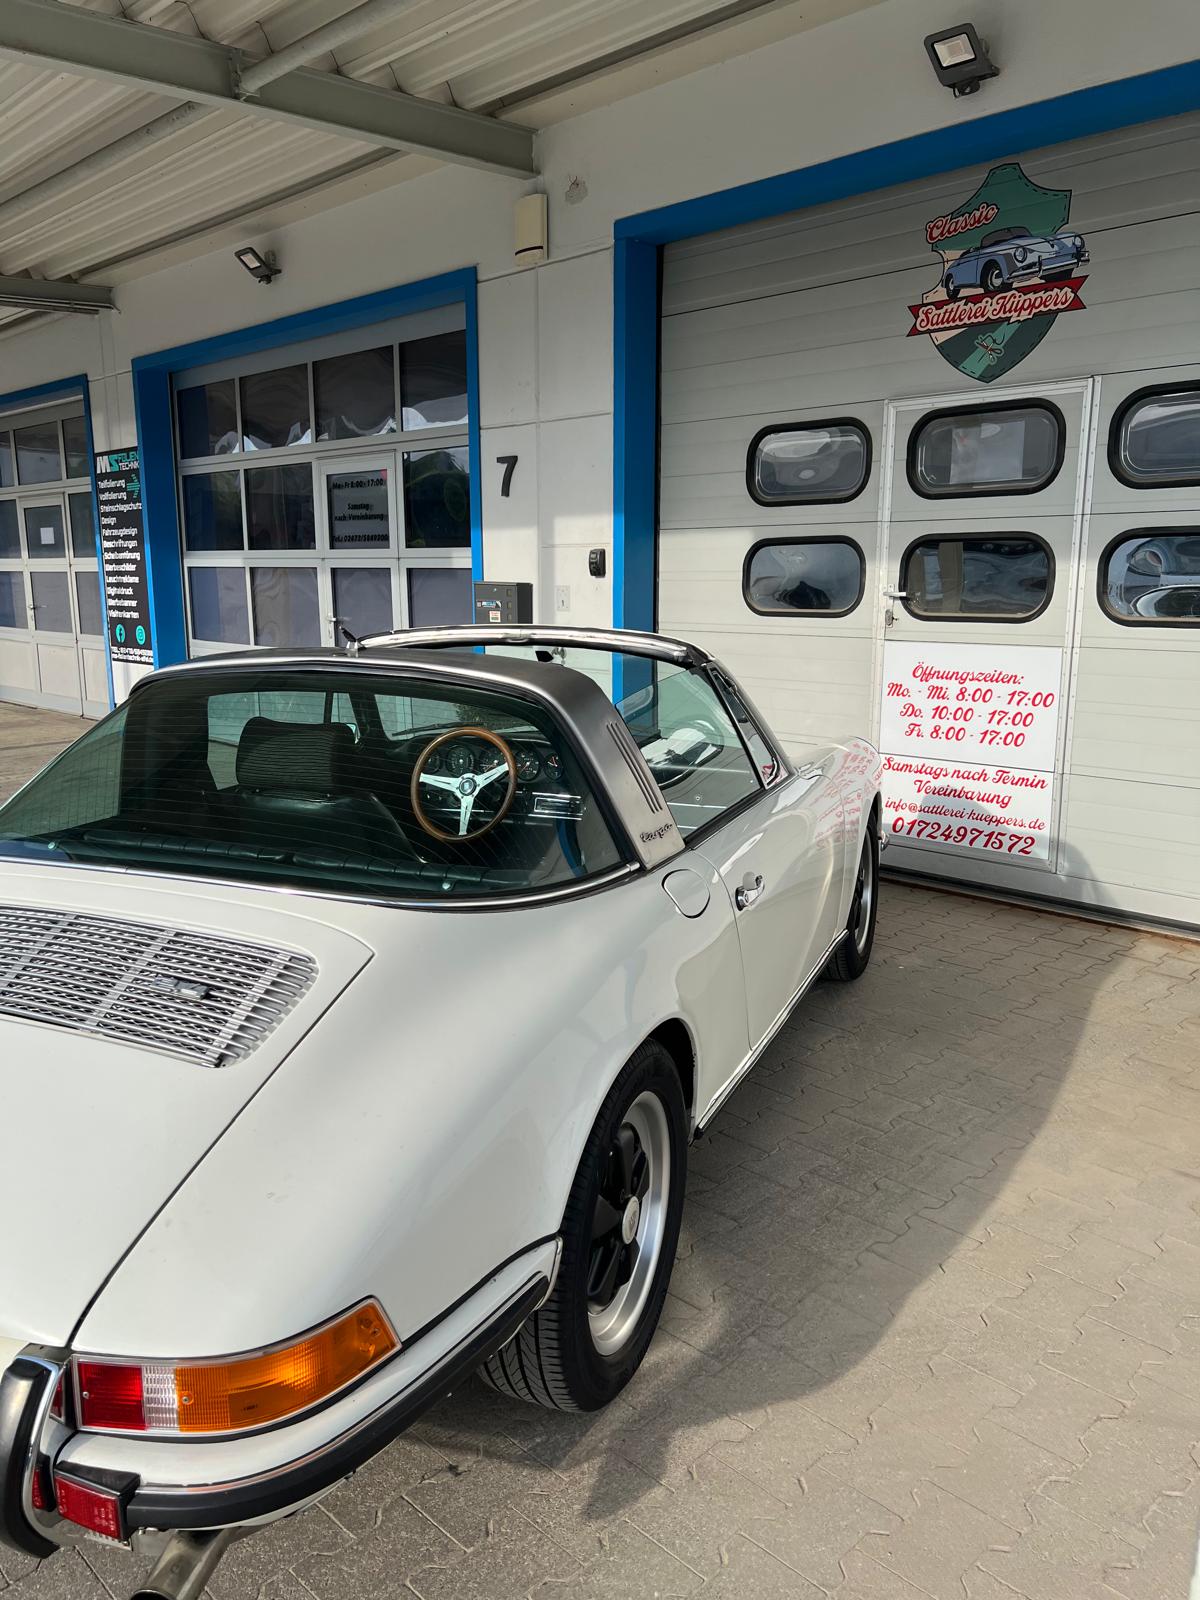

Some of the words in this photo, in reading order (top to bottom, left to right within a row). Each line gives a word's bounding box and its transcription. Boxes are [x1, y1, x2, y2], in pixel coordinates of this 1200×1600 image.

[927, 204, 997, 242] Classic
[918, 299, 988, 329] Sattlerei
[991, 287, 1074, 322] Küppers
[96, 454, 119, 474] MS
[496, 455, 519, 498] 7
[367, 478, 384, 487] 17:00
[100, 502, 142, 513] Steinschlagschutz
[348, 512, 384, 521] Vereinbarung
[101, 516, 117, 525] Design
[102, 526, 138, 537] Fahrzeugdesign
[103, 538, 138, 549] Beschriftungen
[912, 661, 1025, 685] Öffnungszeiten:
[887, 682, 911, 698] Mo.
[926, 684, 950, 700] Mi.
[955, 686, 993, 703] 8:00
[1007, 690, 1055, 708] 17:00
[899, 702, 924, 718] Do.
[931, 705, 974, 722] 10:00
[987, 709, 1034, 727] 17:00
[904, 722, 924, 738] Fr.
[929, 724, 966, 741] 8:00
[979, 729, 1026, 747] 17:00
[882, 756, 949, 780] Samstags
[951, 768, 990, 783] nach
[991, 769, 1049, 790] Termin
[913, 779, 1013, 809] Vereinbarung
[885, 797, 1047, 831] info@sattlerei-kueppers.de
[891, 817, 1036, 855] 01724971572
